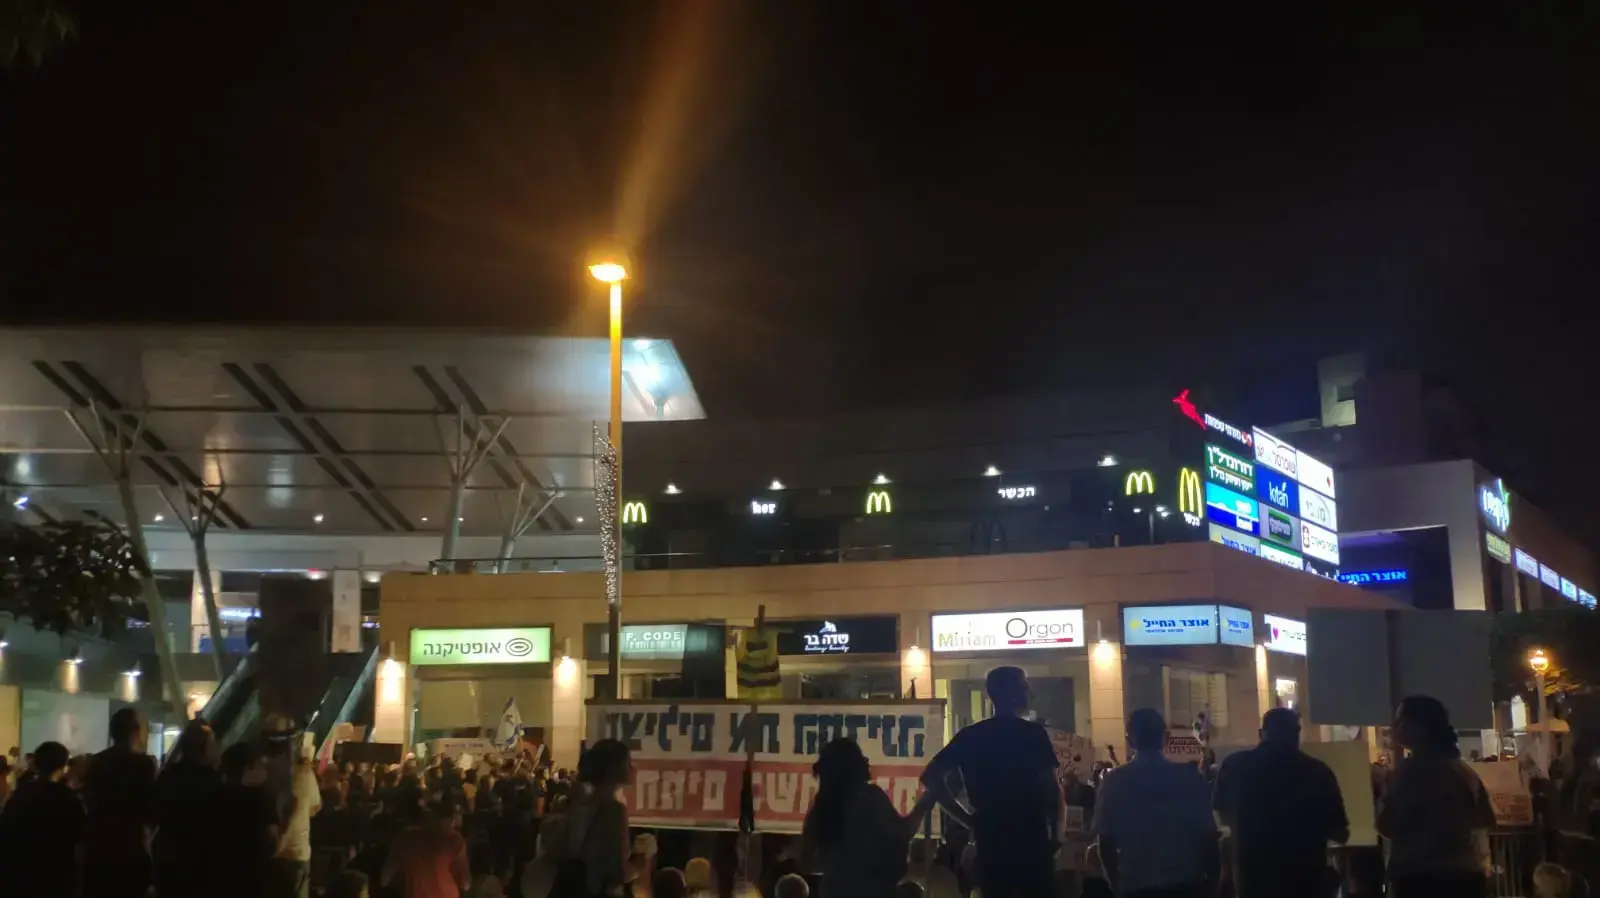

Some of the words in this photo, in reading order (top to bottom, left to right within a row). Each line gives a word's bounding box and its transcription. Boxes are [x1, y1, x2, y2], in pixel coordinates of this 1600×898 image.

[752, 500, 776, 514] her
[1340, 573, 1370, 582] החיי
[1372, 571, 1406, 581] אוצר
[1006, 618, 1074, 638] Orgon
[1142, 618, 1176, 628] החייל
[1183, 619, 1210, 627] אוצר
[642, 632, 681, 641] CODE
[803, 633, 820, 645] בר
[822, 633, 850, 645] שדה
[938, 632, 996, 648] Miriam
[423, 641, 501, 657] אופטיקנה
